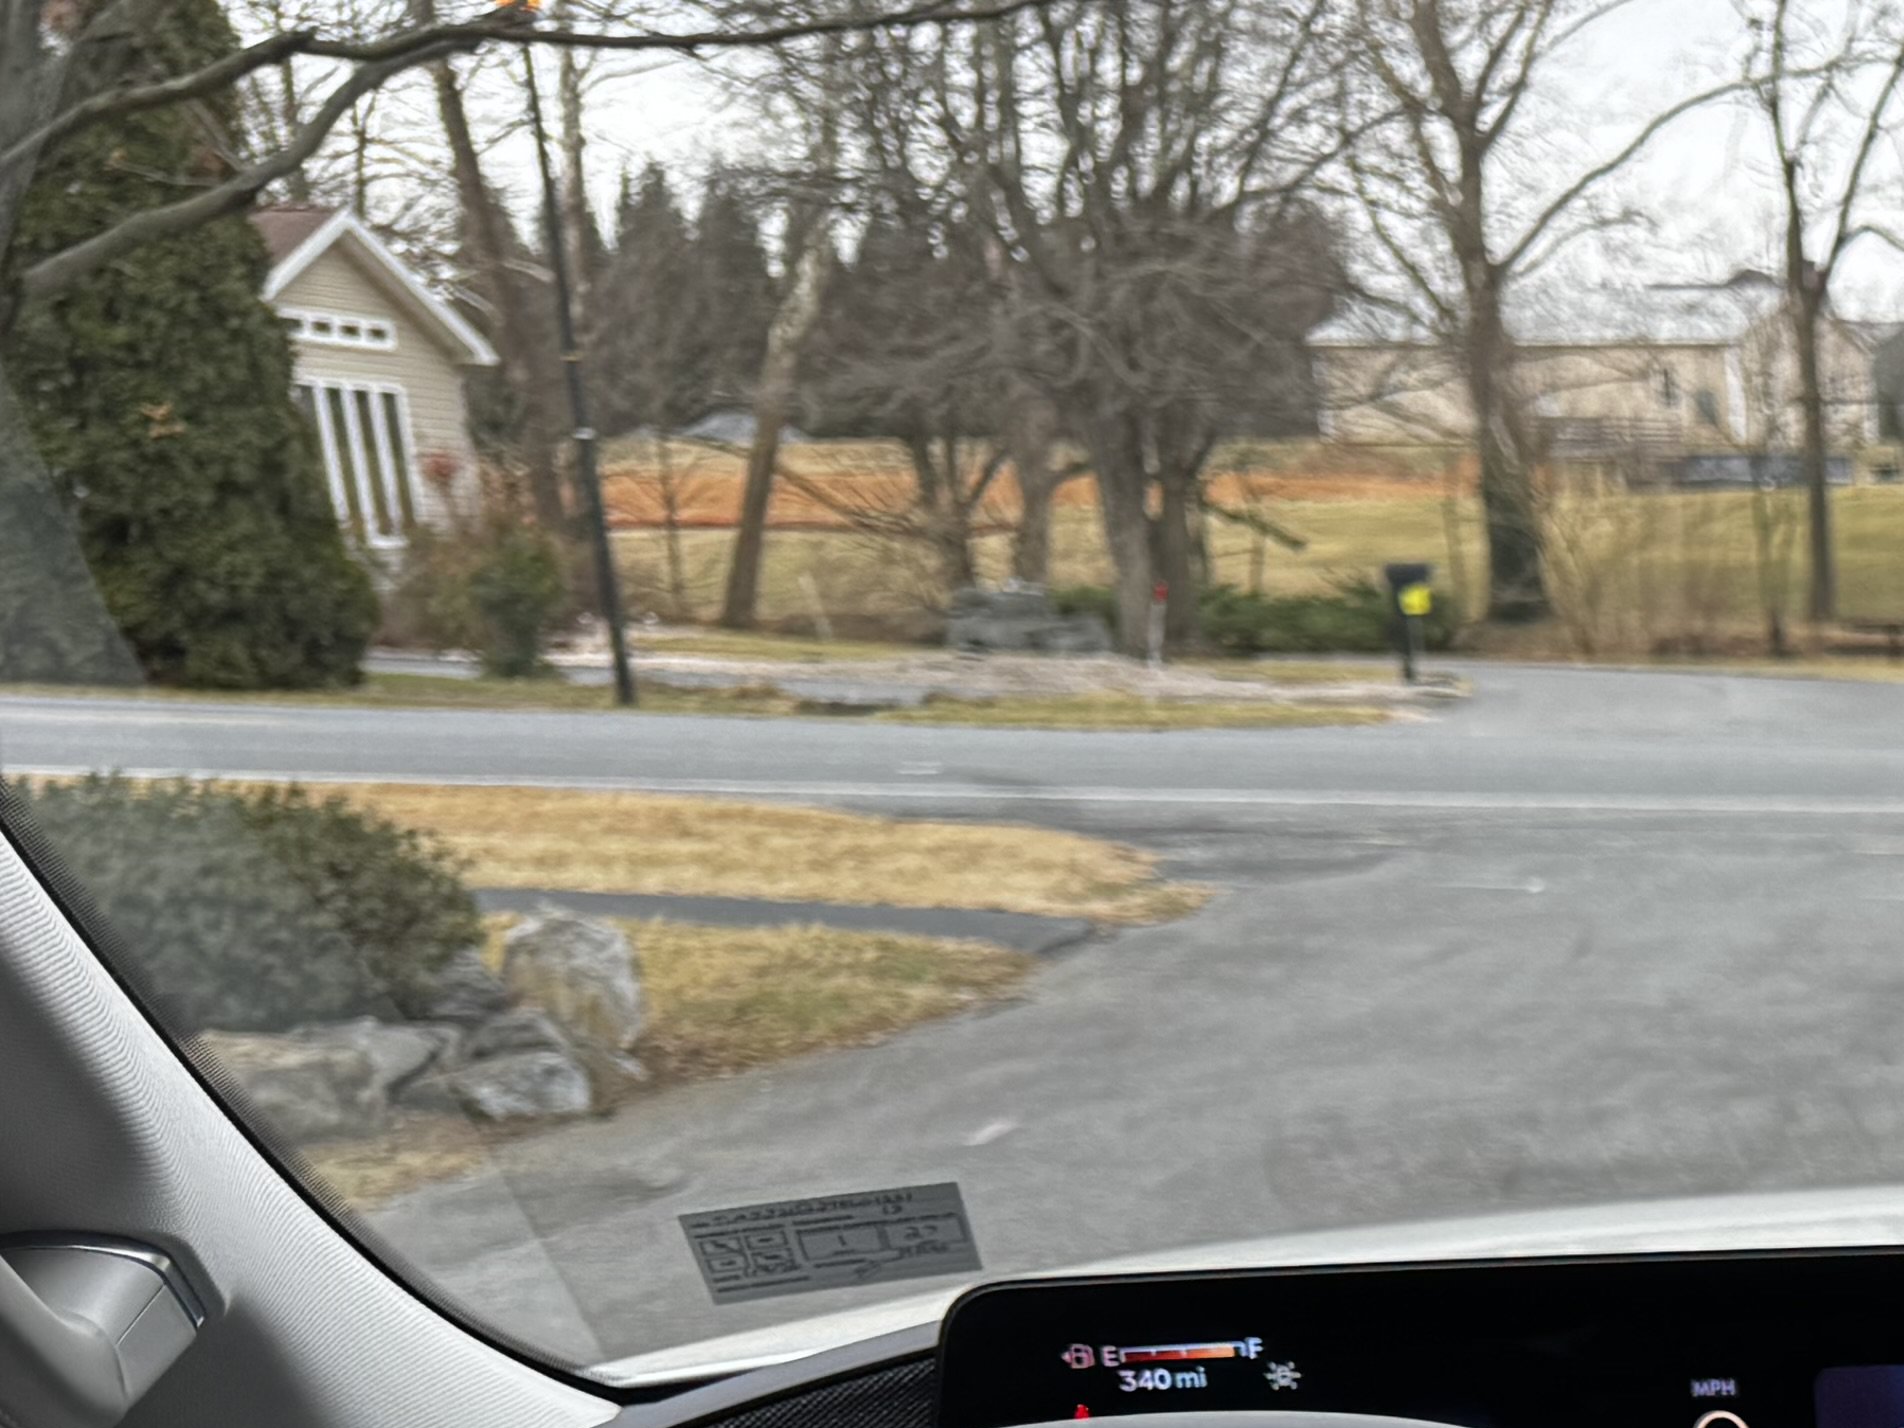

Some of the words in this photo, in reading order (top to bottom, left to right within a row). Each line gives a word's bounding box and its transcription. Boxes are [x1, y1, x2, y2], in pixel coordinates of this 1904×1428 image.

[1119, 1368, 1171, 1393] 340
[1175, 1365, 1207, 1390] mi
[1691, 1378, 1737, 1398] MPH
